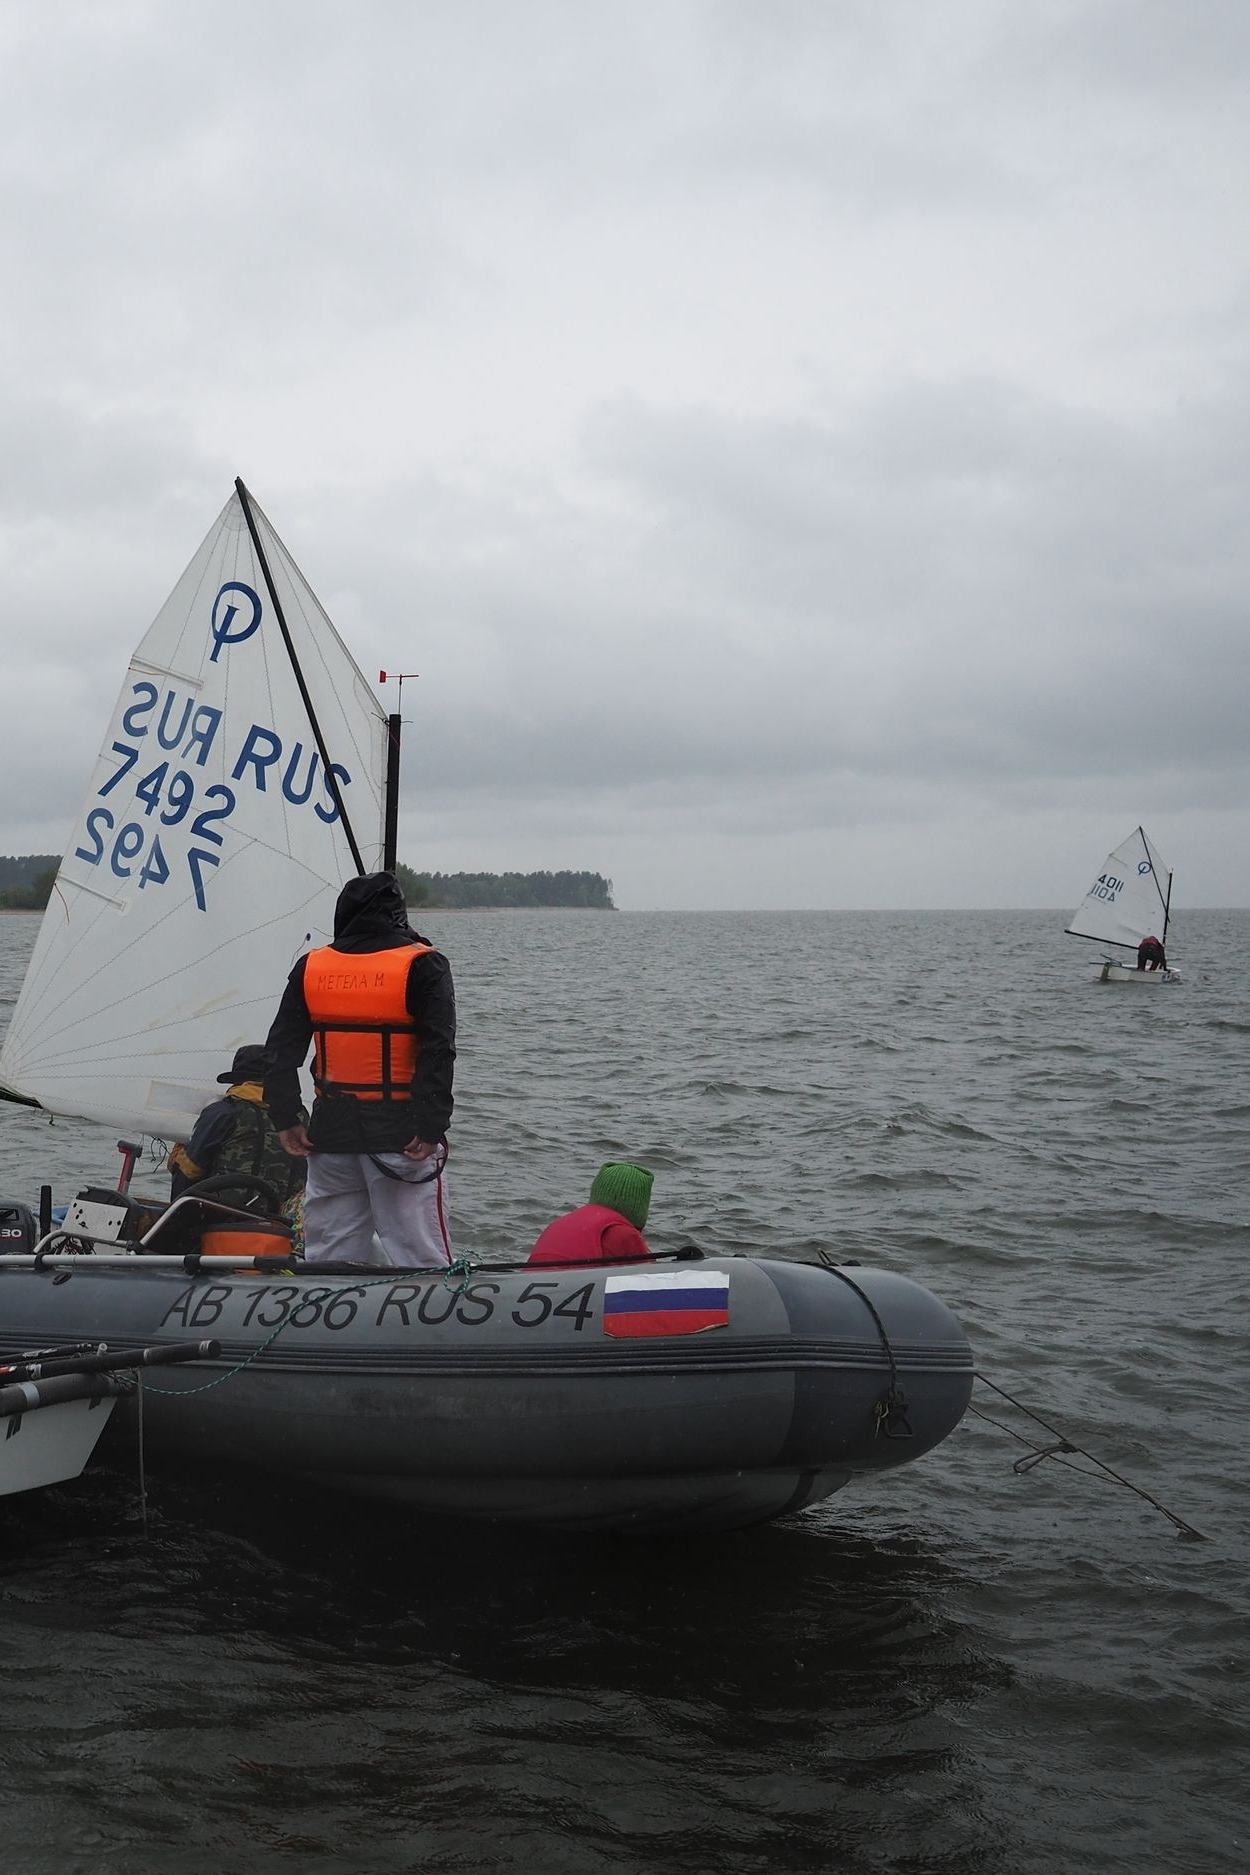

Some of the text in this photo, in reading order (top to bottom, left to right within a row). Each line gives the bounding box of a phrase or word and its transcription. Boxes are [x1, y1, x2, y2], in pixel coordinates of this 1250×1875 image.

[97, 742, 237, 847] 7492
[231, 724, 352, 824] RUS
[1098, 873, 1125, 893] 4011
[1, 1228, 22, 1238] 30
[159, 1282, 596, 1332] AB 1386 RUS 54
